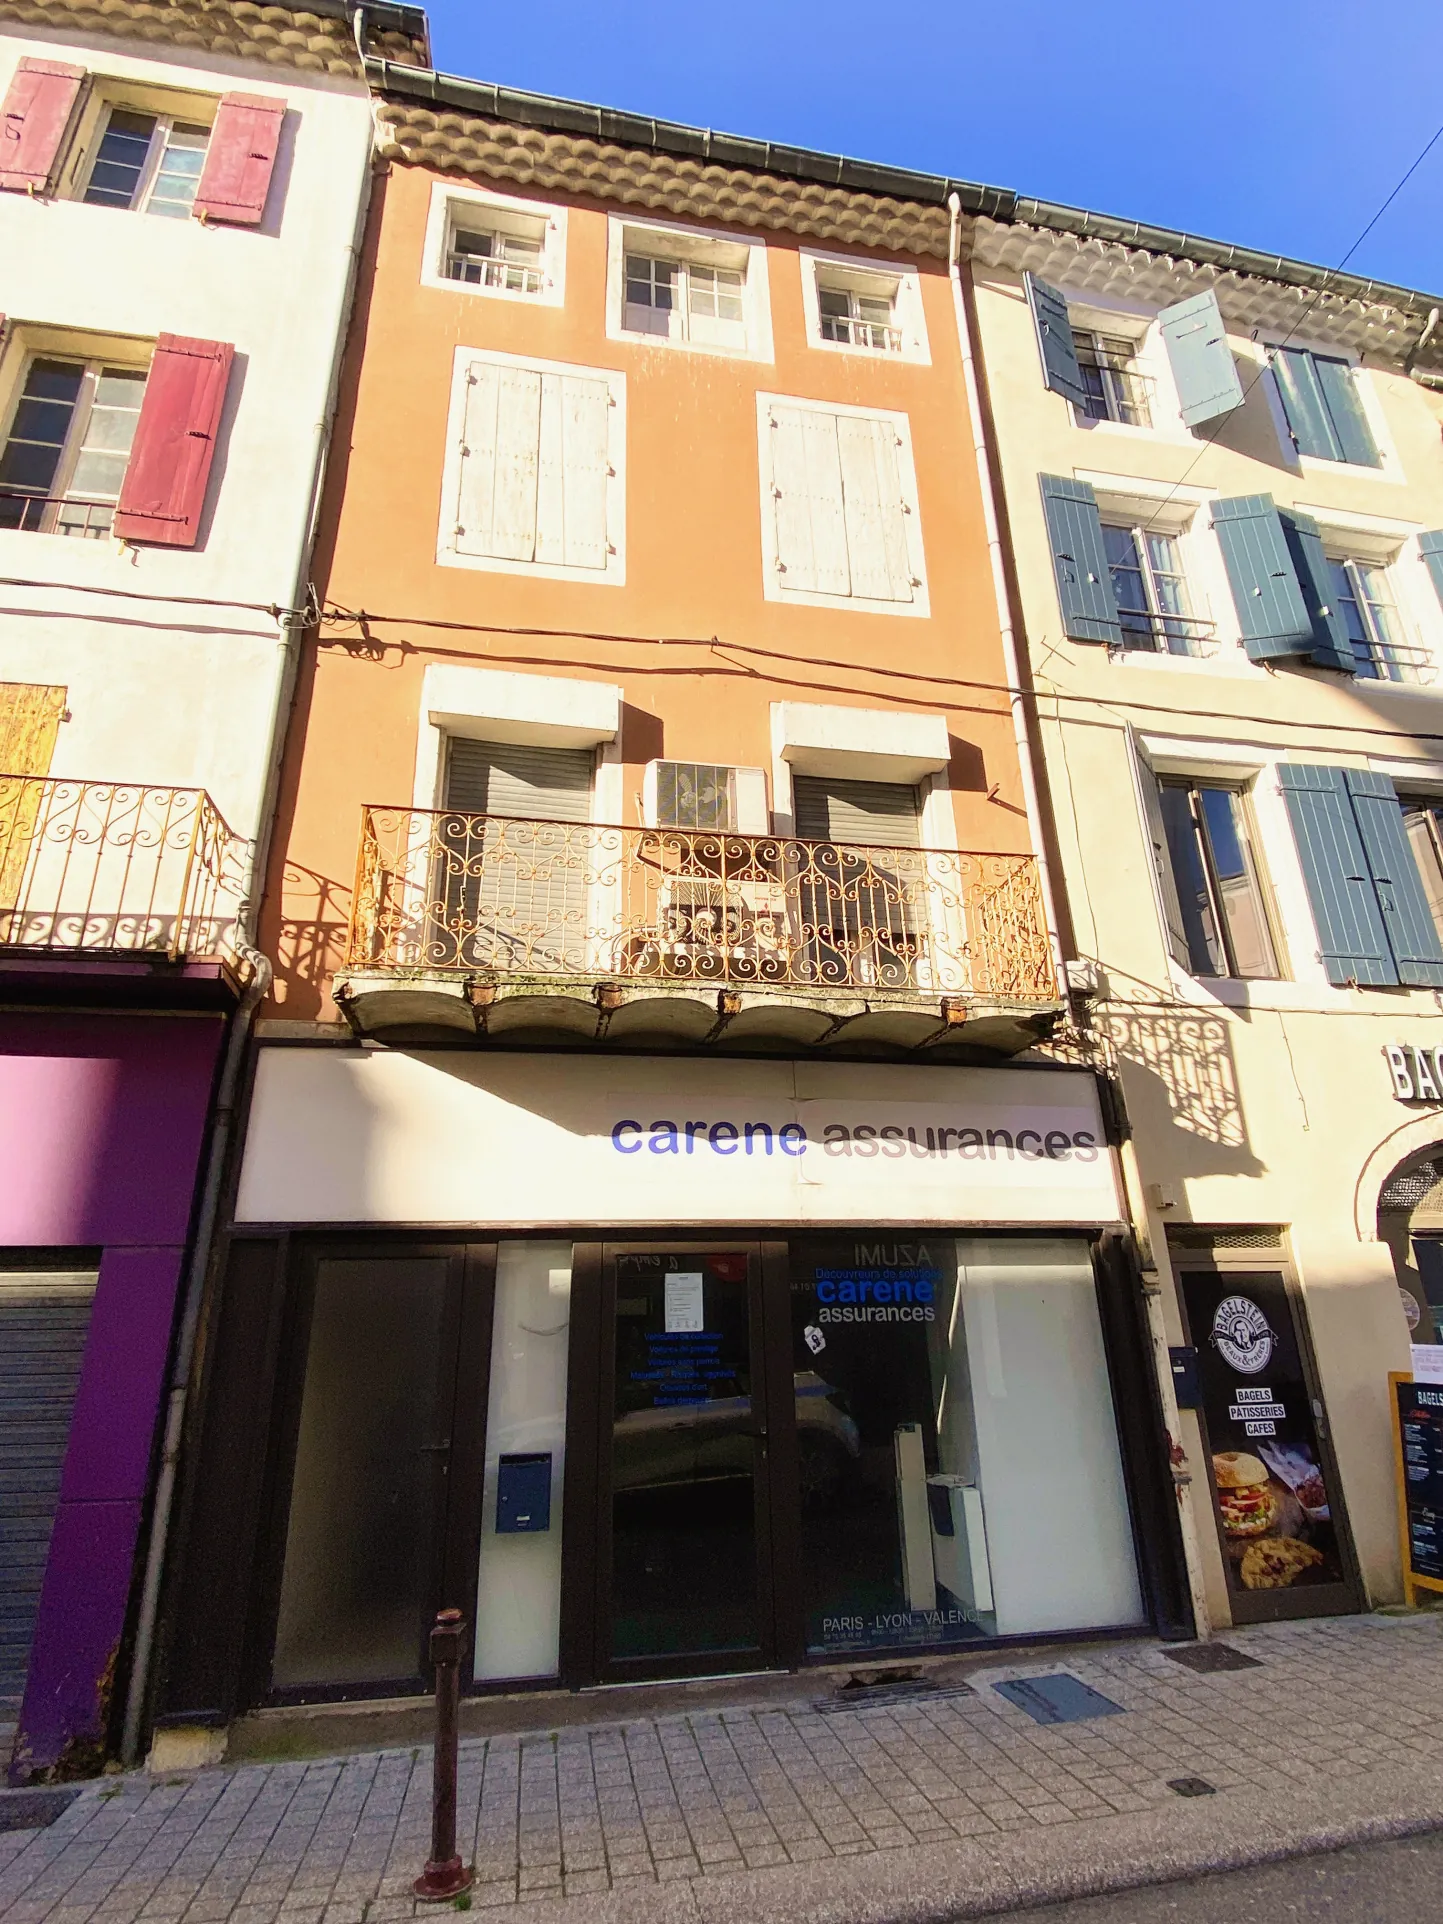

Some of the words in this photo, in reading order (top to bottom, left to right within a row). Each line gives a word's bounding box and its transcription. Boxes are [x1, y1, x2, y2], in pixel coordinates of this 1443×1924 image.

[611, 1119, 807, 1156] carene
[823, 1123, 1099, 1163] assurances
[816, 1280, 934, 1303] carene
[819, 1306, 936, 1323] assurances
[1216, 1299, 1266, 1331] BAGELSTEIN
[1238, 1390, 1271, 1401] BAGELS
[823, 1617, 863, 1632] PARIS
[876, 1614, 912, 1629] LYON
[924, 1609, 983, 1625] VALENCE
